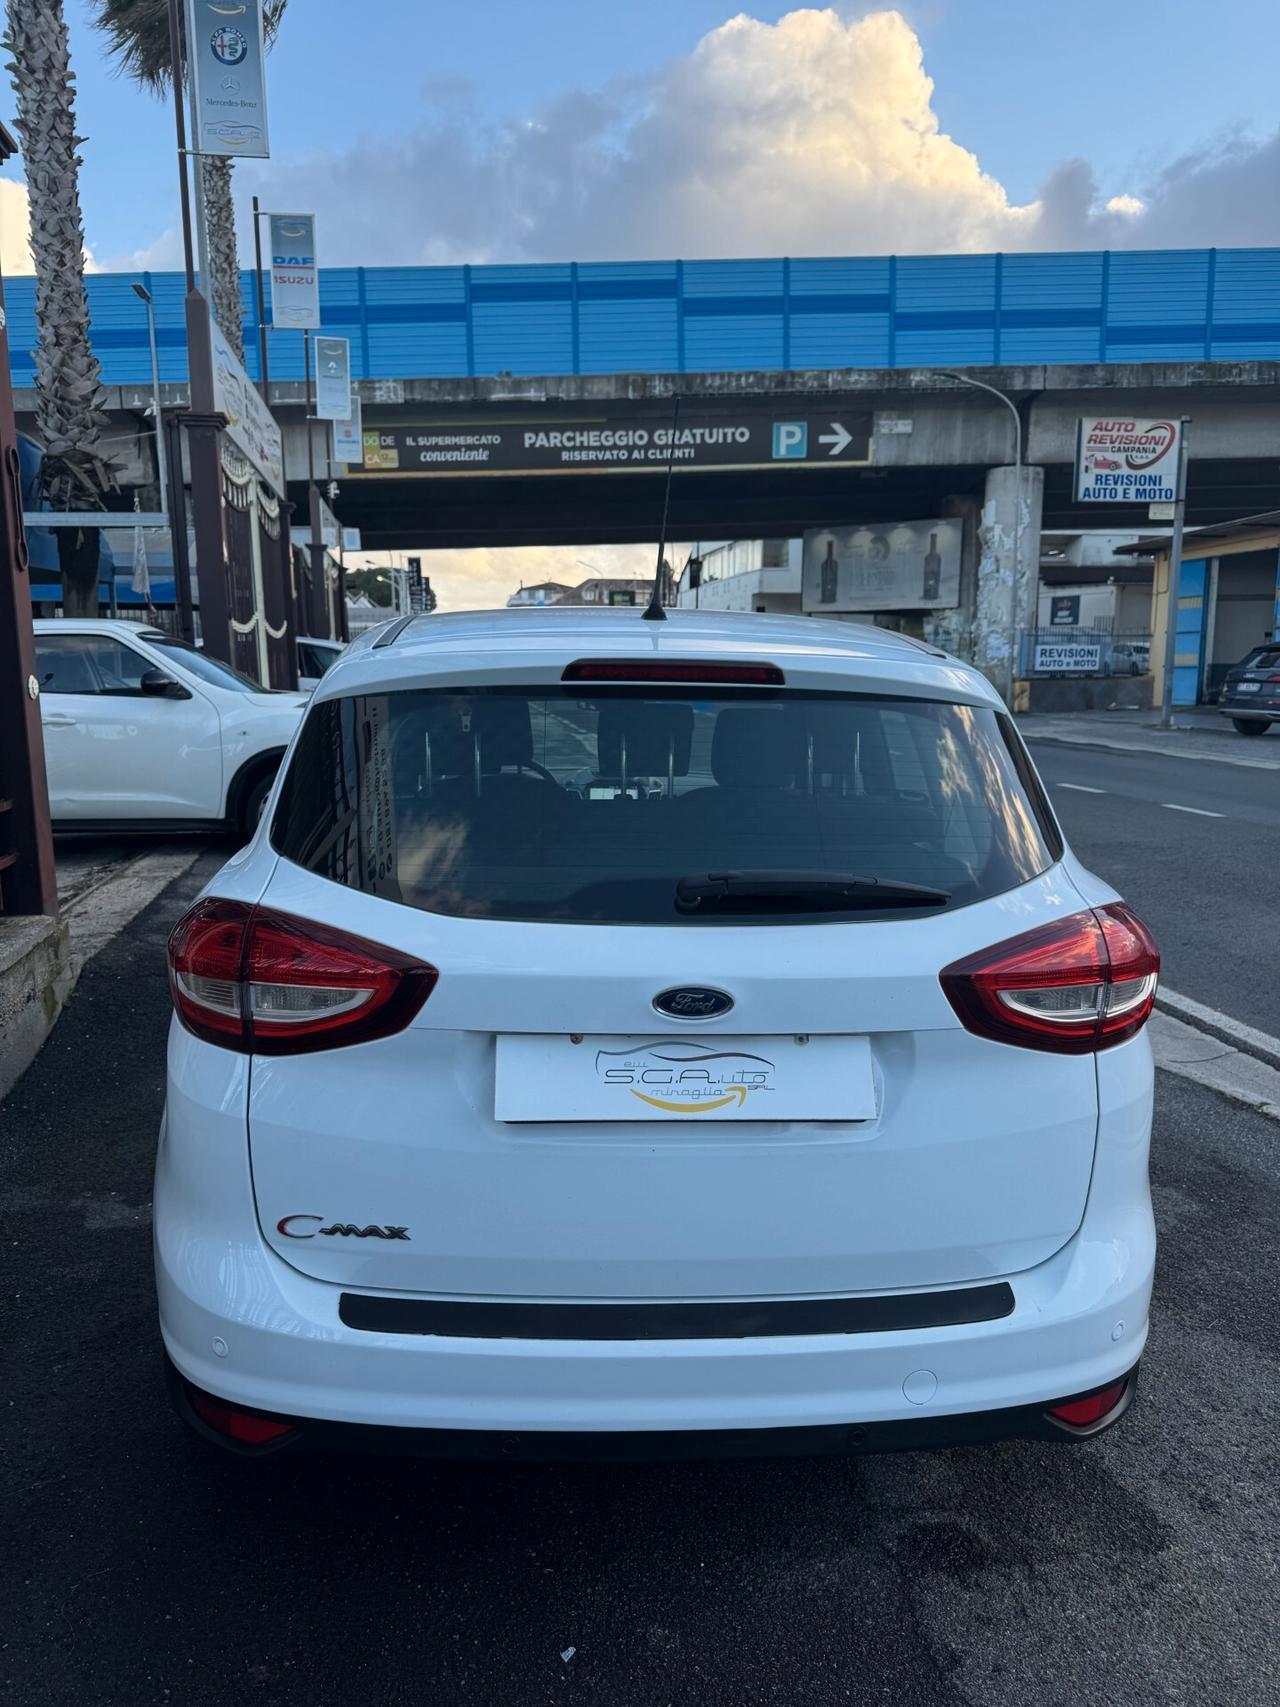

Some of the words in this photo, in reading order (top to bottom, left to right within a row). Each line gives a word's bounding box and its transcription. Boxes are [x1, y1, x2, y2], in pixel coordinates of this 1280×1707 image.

[206, 98, 257, 108] Mercedes-Benz
[272, 256, 314, 265] DAF
[274, 275, 314, 285] ISUZU
[1092, 421, 1136, 433] AUTO
[406, 437, 416, 446] IL
[418, 435, 501, 446] SUPERMERCATO
[523, 430, 649, 448] PARCHEGGIO
[653, 427, 750, 446] GRATUITO
[779, 425, 802, 455] P
[1087, 434, 1167, 446] REVISIONI
[420, 448, 490, 462] conveniente
[561, 449, 628, 462] RISERVATO
[632, 448, 645, 460] AI
[647, 447, 695, 460] CLIENTI
[1111, 446, 1157, 454] CAMPANIA
[1094, 474, 1163, 486] REVISIONI
[1082, 487, 1118, 499] AUTO
[1122, 487, 1131, 499] E
[1135, 488, 1173, 500] MOTO
[1039, 647, 1098, 658] REVISIONI
[1039, 659, 1063, 668] AUTO
[1073, 659, 1097, 668] MOTO
[671, 993, 716, 1012] Ford
[650, 1087, 727, 1100] miraglia
